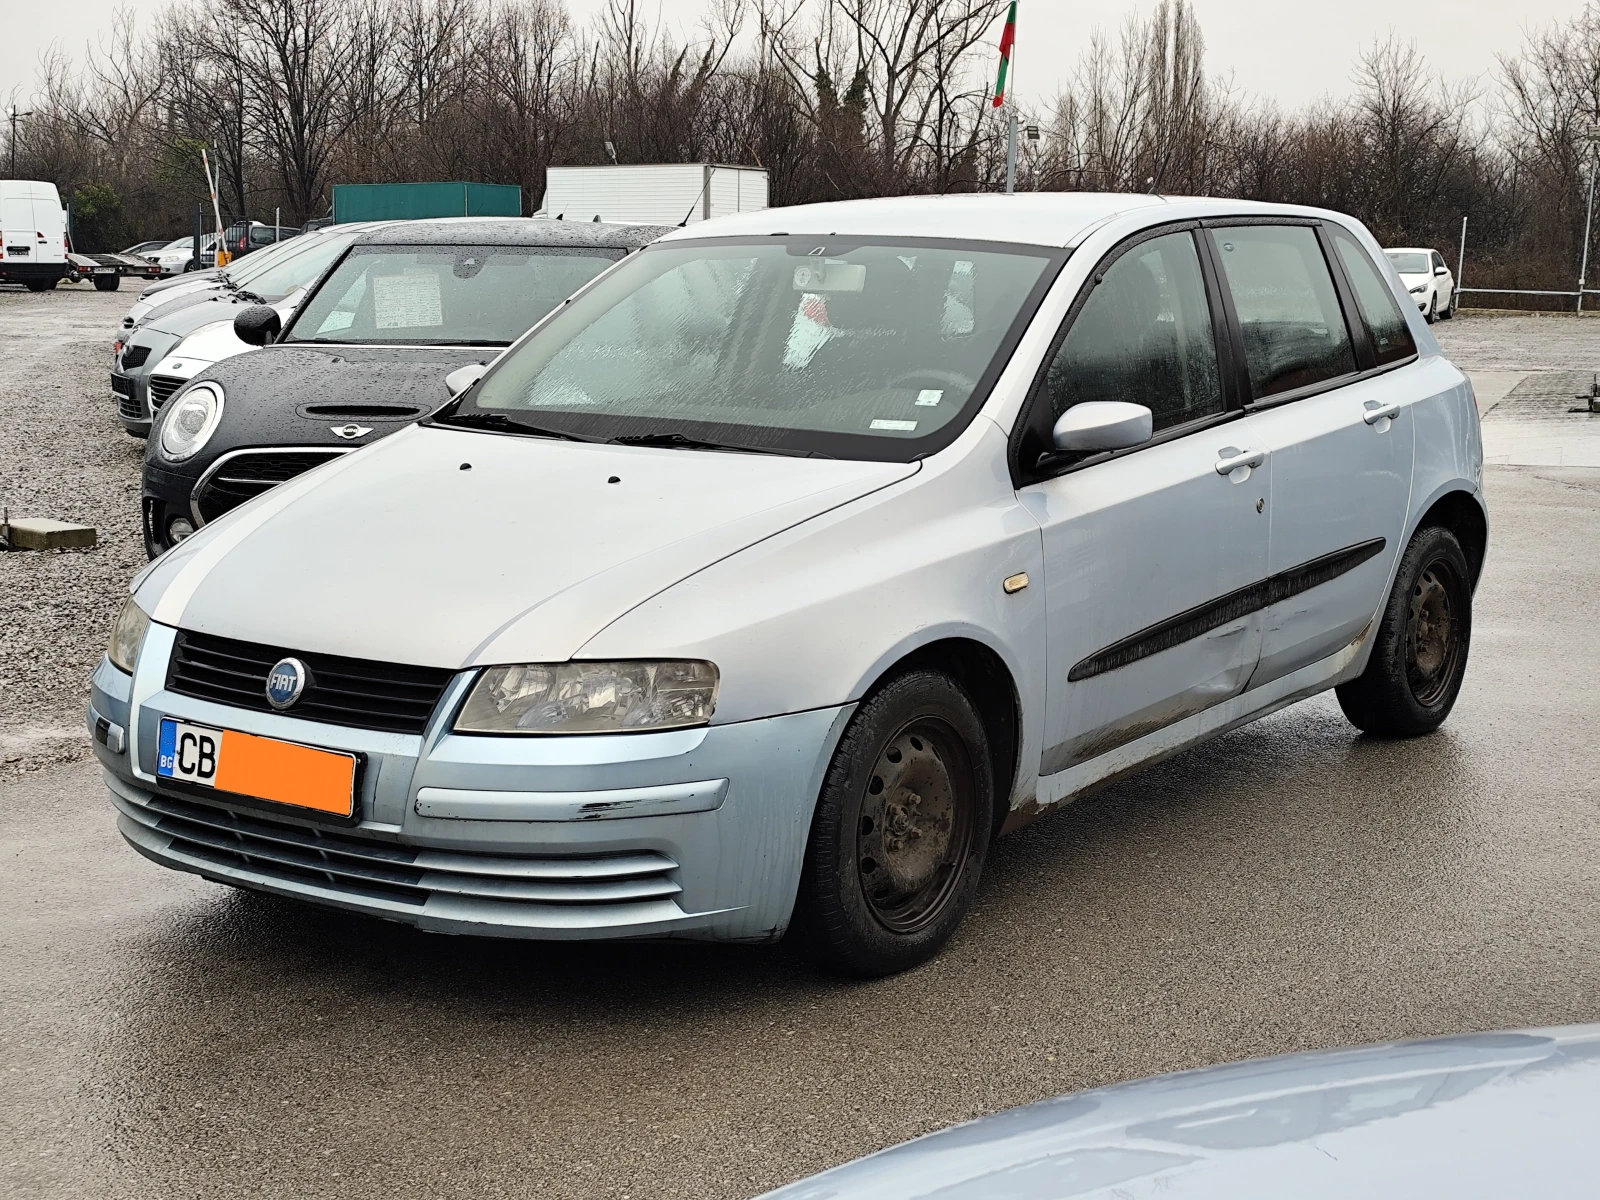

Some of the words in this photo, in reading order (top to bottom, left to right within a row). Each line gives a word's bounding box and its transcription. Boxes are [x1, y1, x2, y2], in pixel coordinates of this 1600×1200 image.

[269, 673, 297, 692] FIAT
[160, 754, 173, 769] BG
[178, 731, 215, 778] CB
